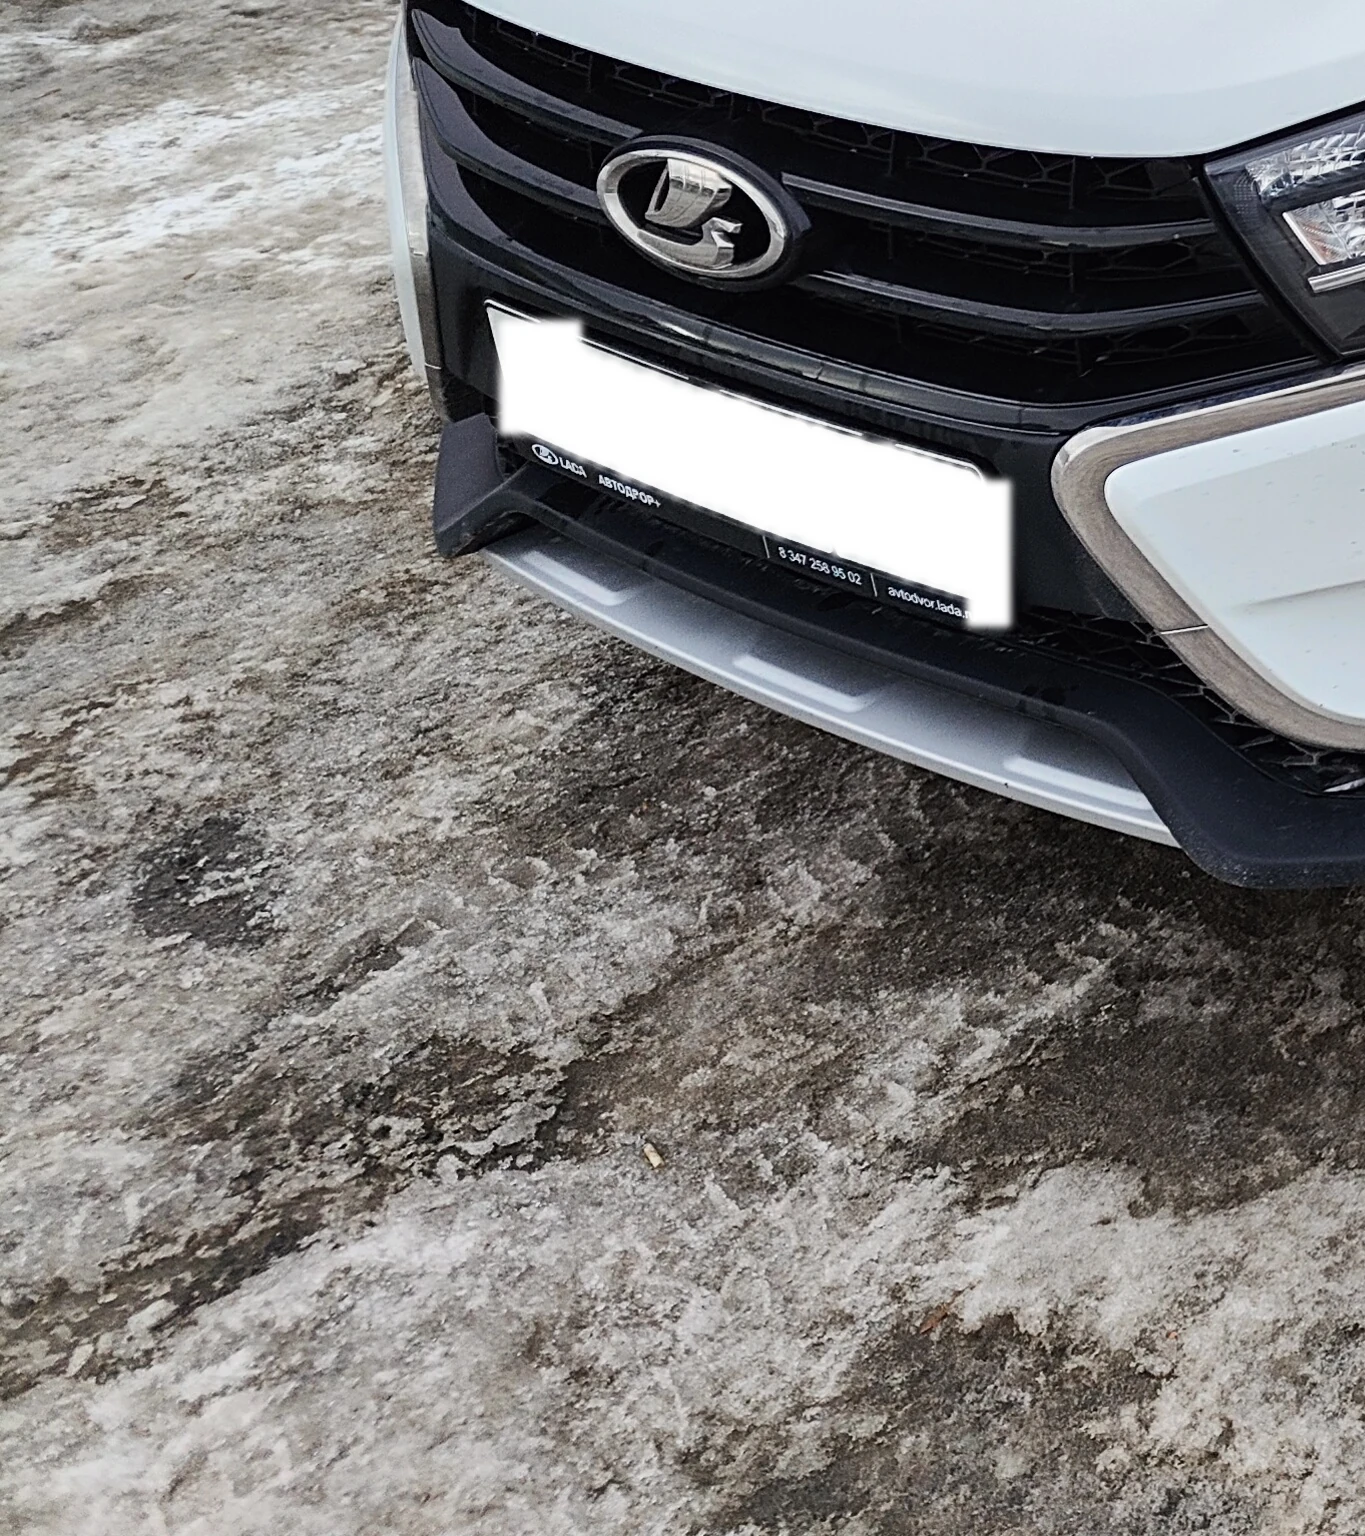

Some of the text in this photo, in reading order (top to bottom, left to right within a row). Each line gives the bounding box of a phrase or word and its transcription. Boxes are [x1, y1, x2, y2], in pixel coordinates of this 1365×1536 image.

[559, 457, 587, 478] LADA
[778, 546, 862, 586] 8 347 258 95 02
[888, 585, 972, 620] avtodvor.lada.r
